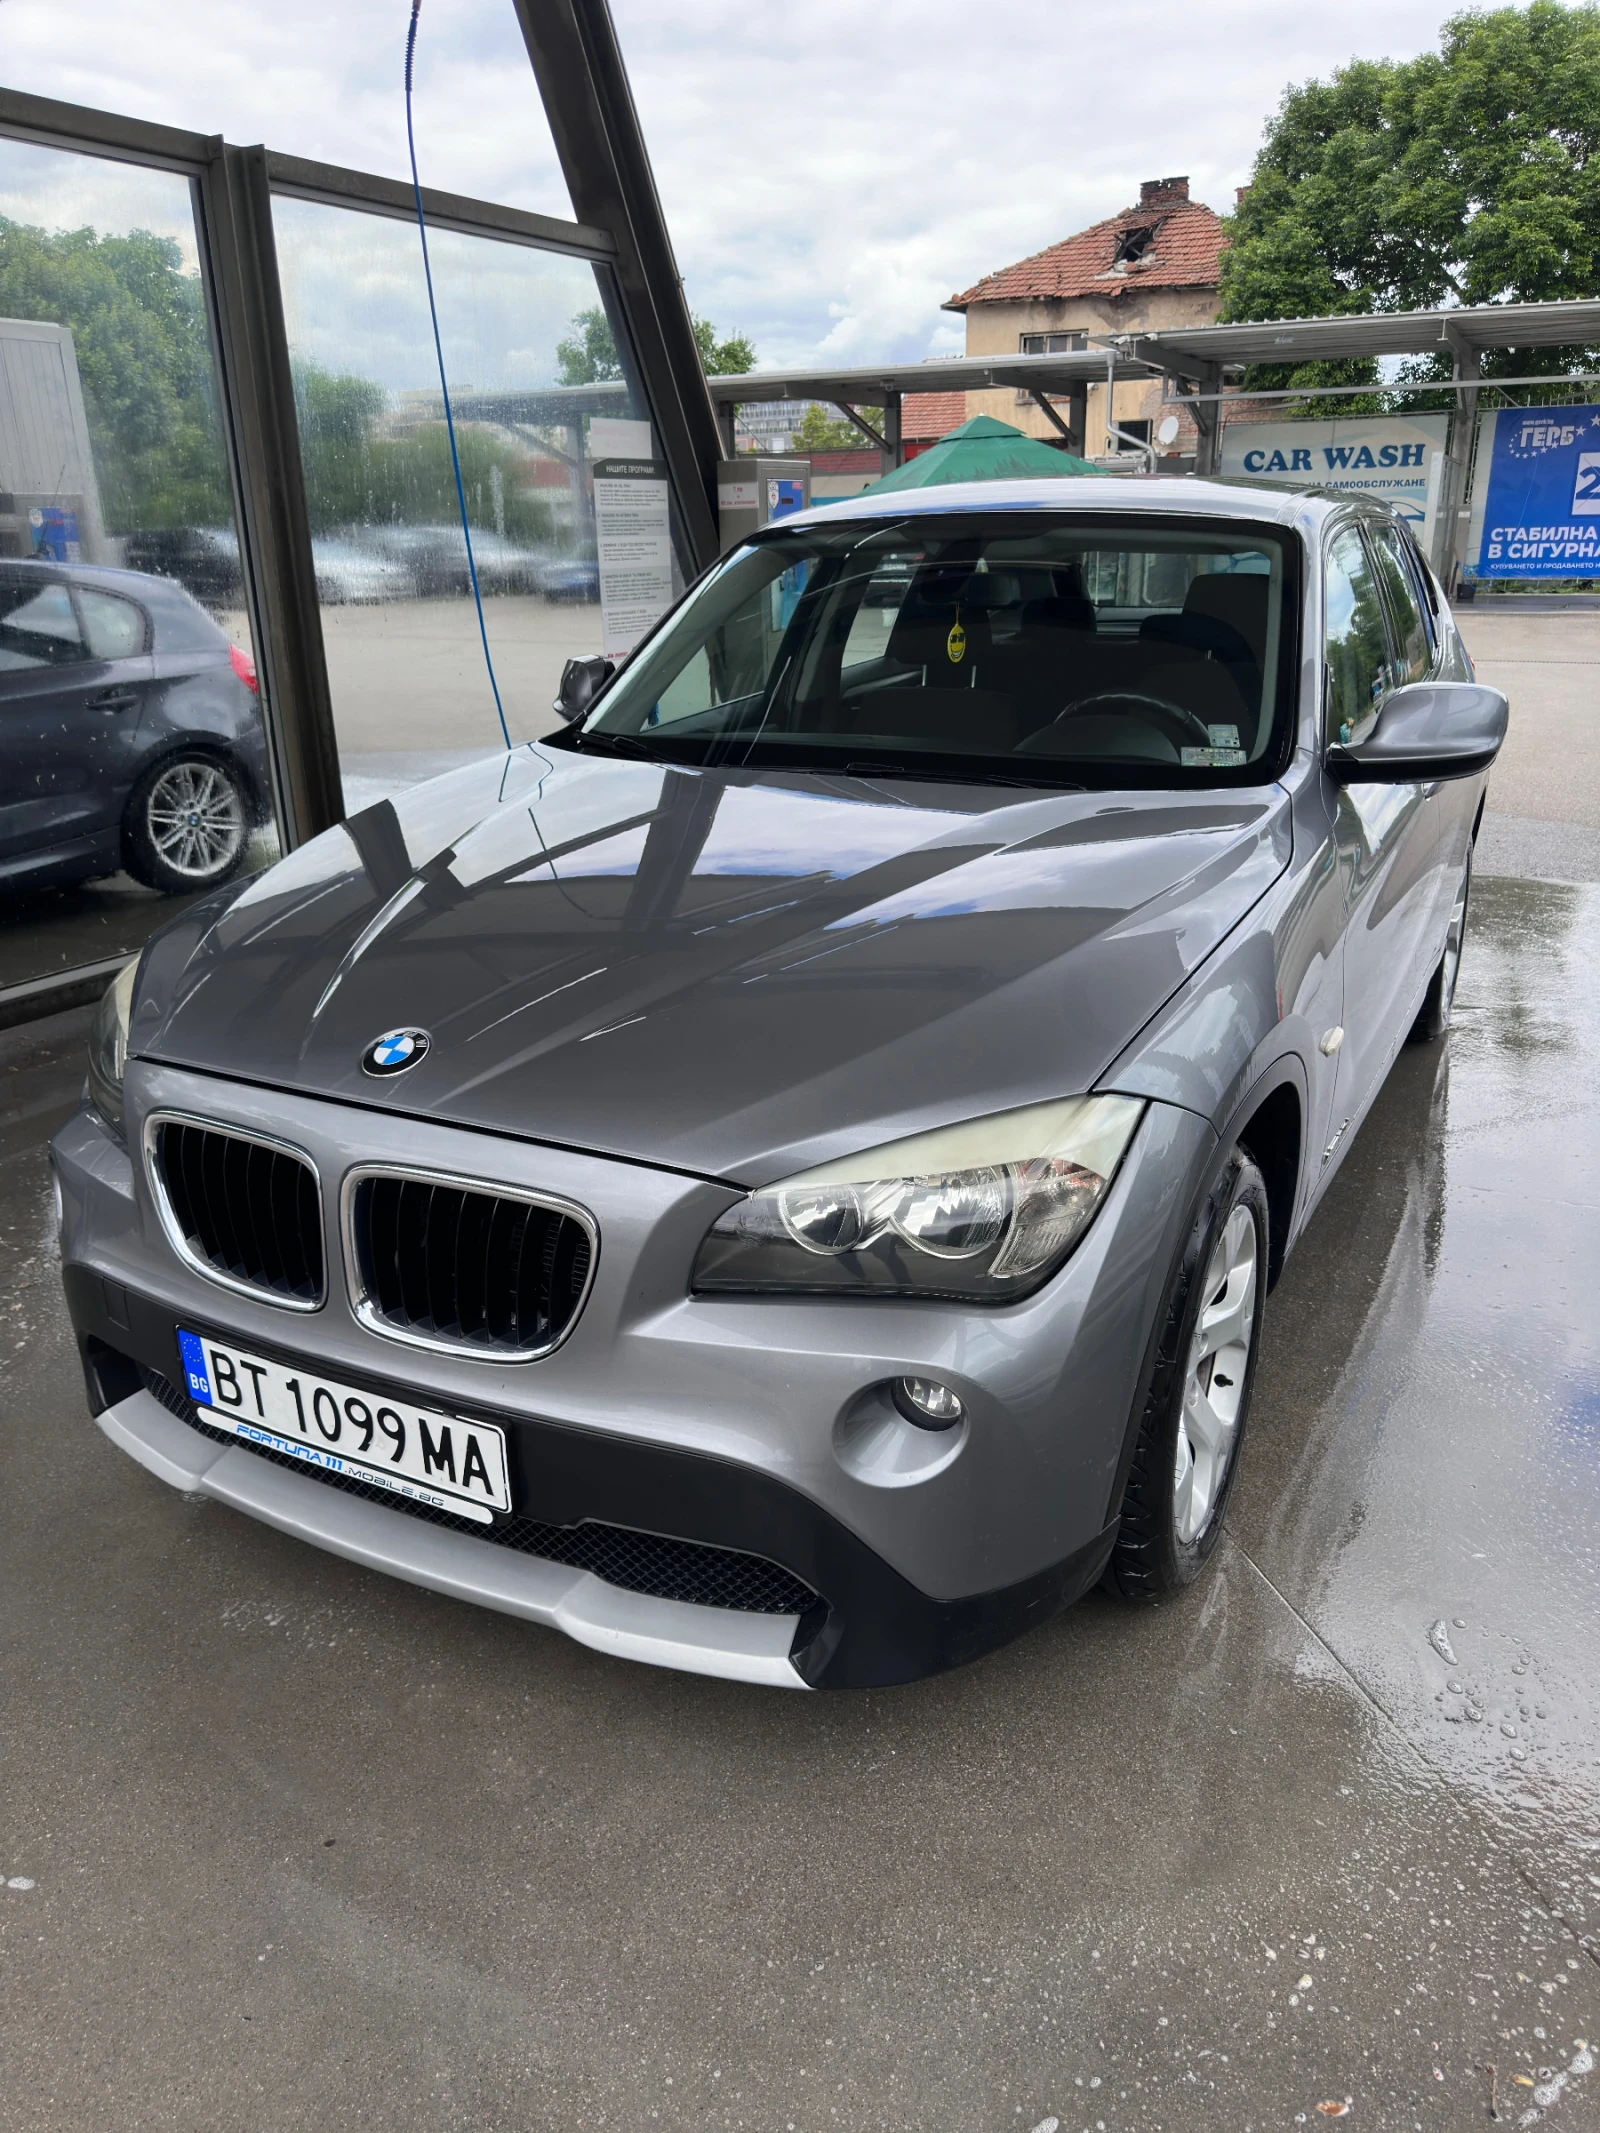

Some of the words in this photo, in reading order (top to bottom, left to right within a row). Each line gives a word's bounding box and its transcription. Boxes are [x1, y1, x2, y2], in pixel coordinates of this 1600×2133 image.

[1520, 426, 1575, 448] ГЕРБ
[1243, 449, 1313, 473] CAR
[1323, 444, 1426, 470] WASH
[1325, 479, 1426, 489] САМООБСЛУЖАНЕ
[1490, 526, 1598, 541] СТАБИЛНА
[1488, 544, 1502, 559] В
[190, 1372, 209, 1394] BG
[286, 1378, 407, 1464] 1099
[418, 1417, 495, 1497] MA
